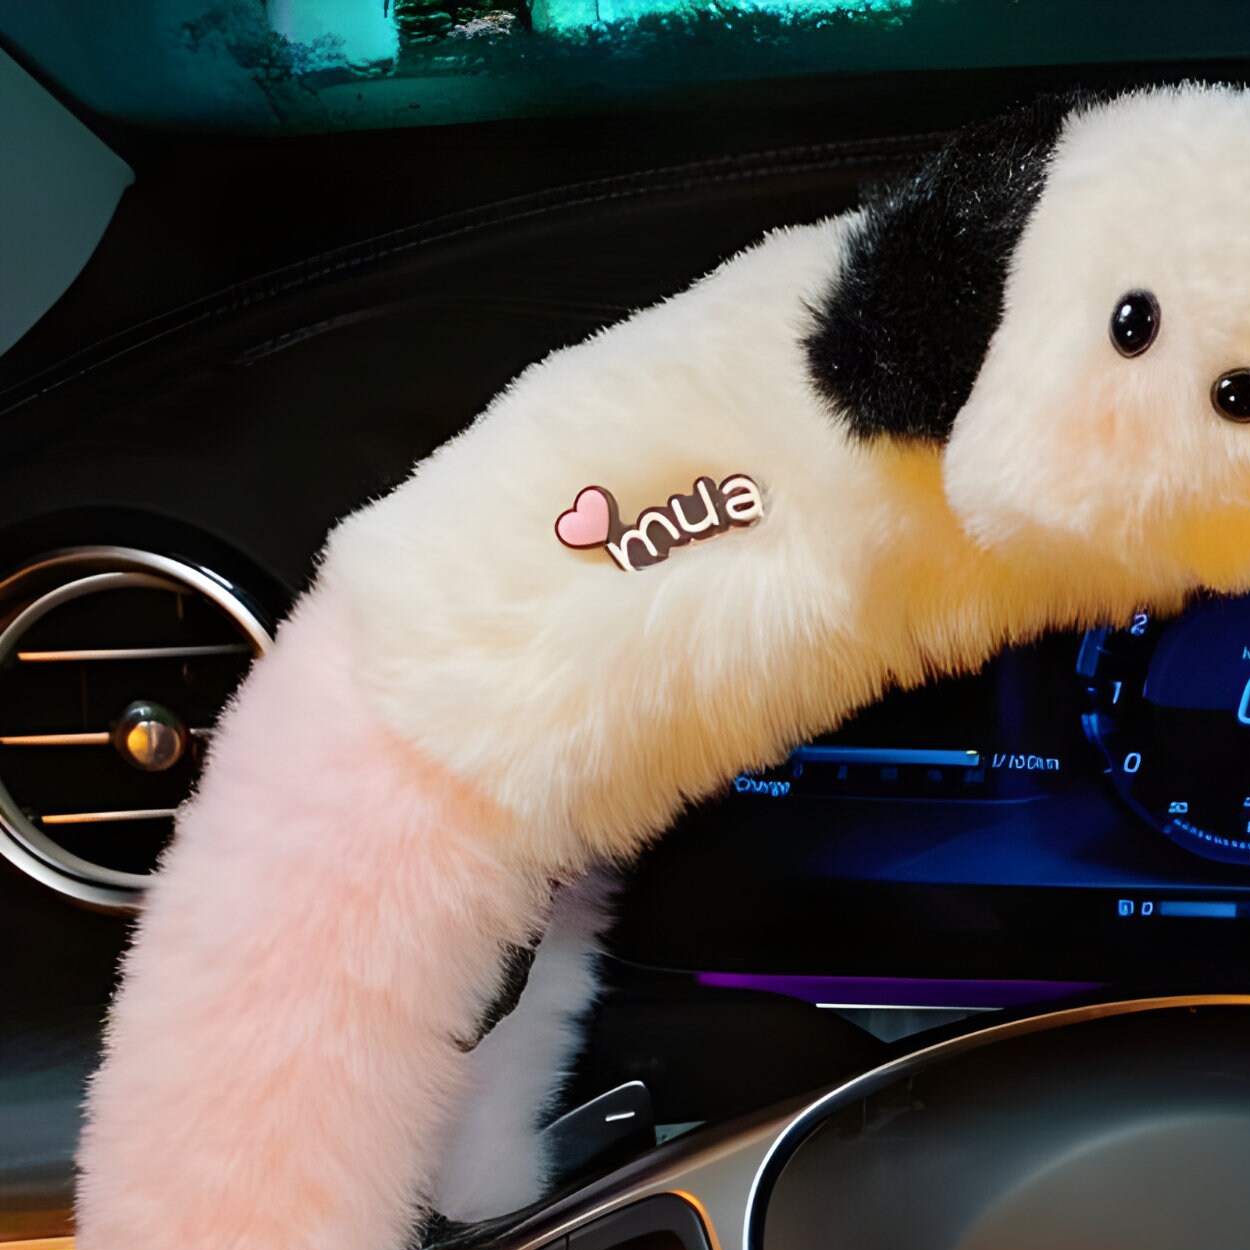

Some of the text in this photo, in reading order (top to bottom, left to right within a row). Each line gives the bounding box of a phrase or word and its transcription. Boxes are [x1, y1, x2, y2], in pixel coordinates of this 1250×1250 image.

[605, 476, 764, 571] mua
[1112, 680, 1122, 704] 1
[1123, 752, 1142, 773] 0
